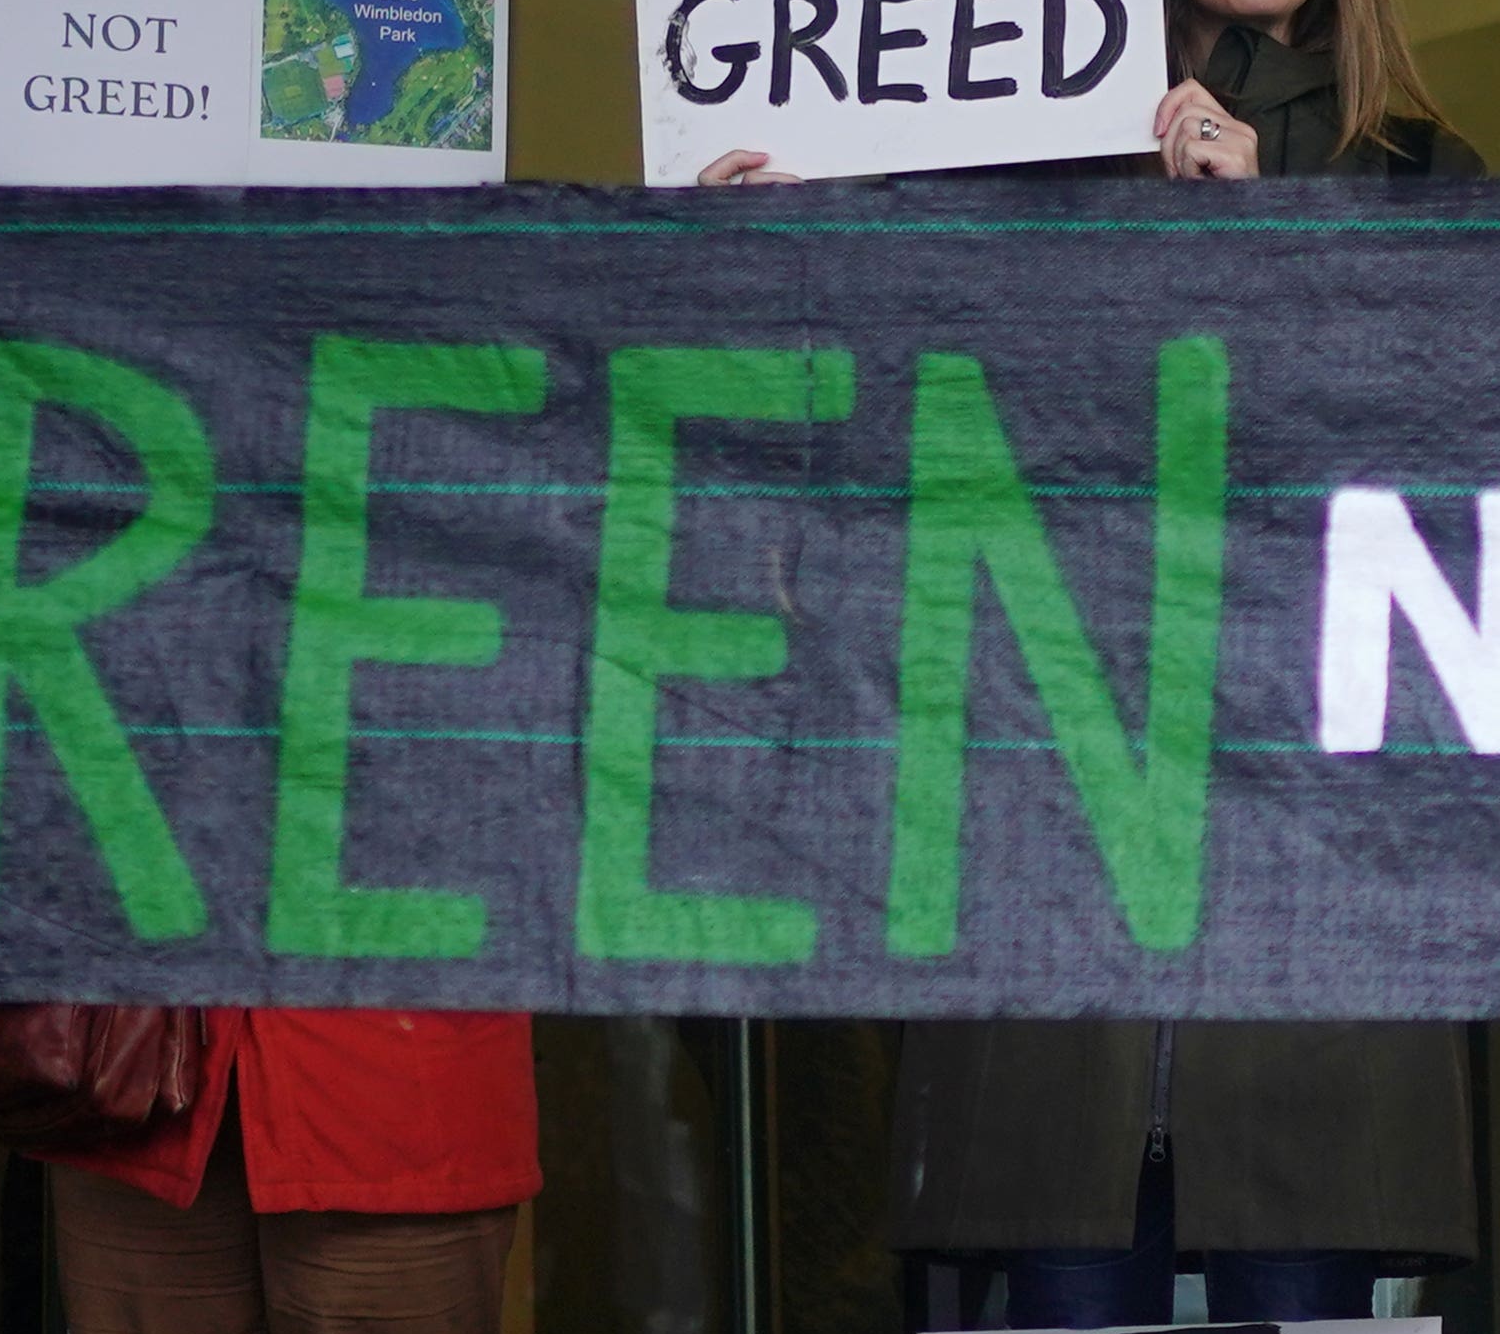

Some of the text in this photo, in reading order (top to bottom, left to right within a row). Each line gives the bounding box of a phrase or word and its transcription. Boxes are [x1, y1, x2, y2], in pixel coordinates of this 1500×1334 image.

[354, 3, 443, 24] Wimbledon
[62, 12, 179, 53] NOT
[379, 28, 417, 43] Park
[24, 75, 210, 120] GREED!
